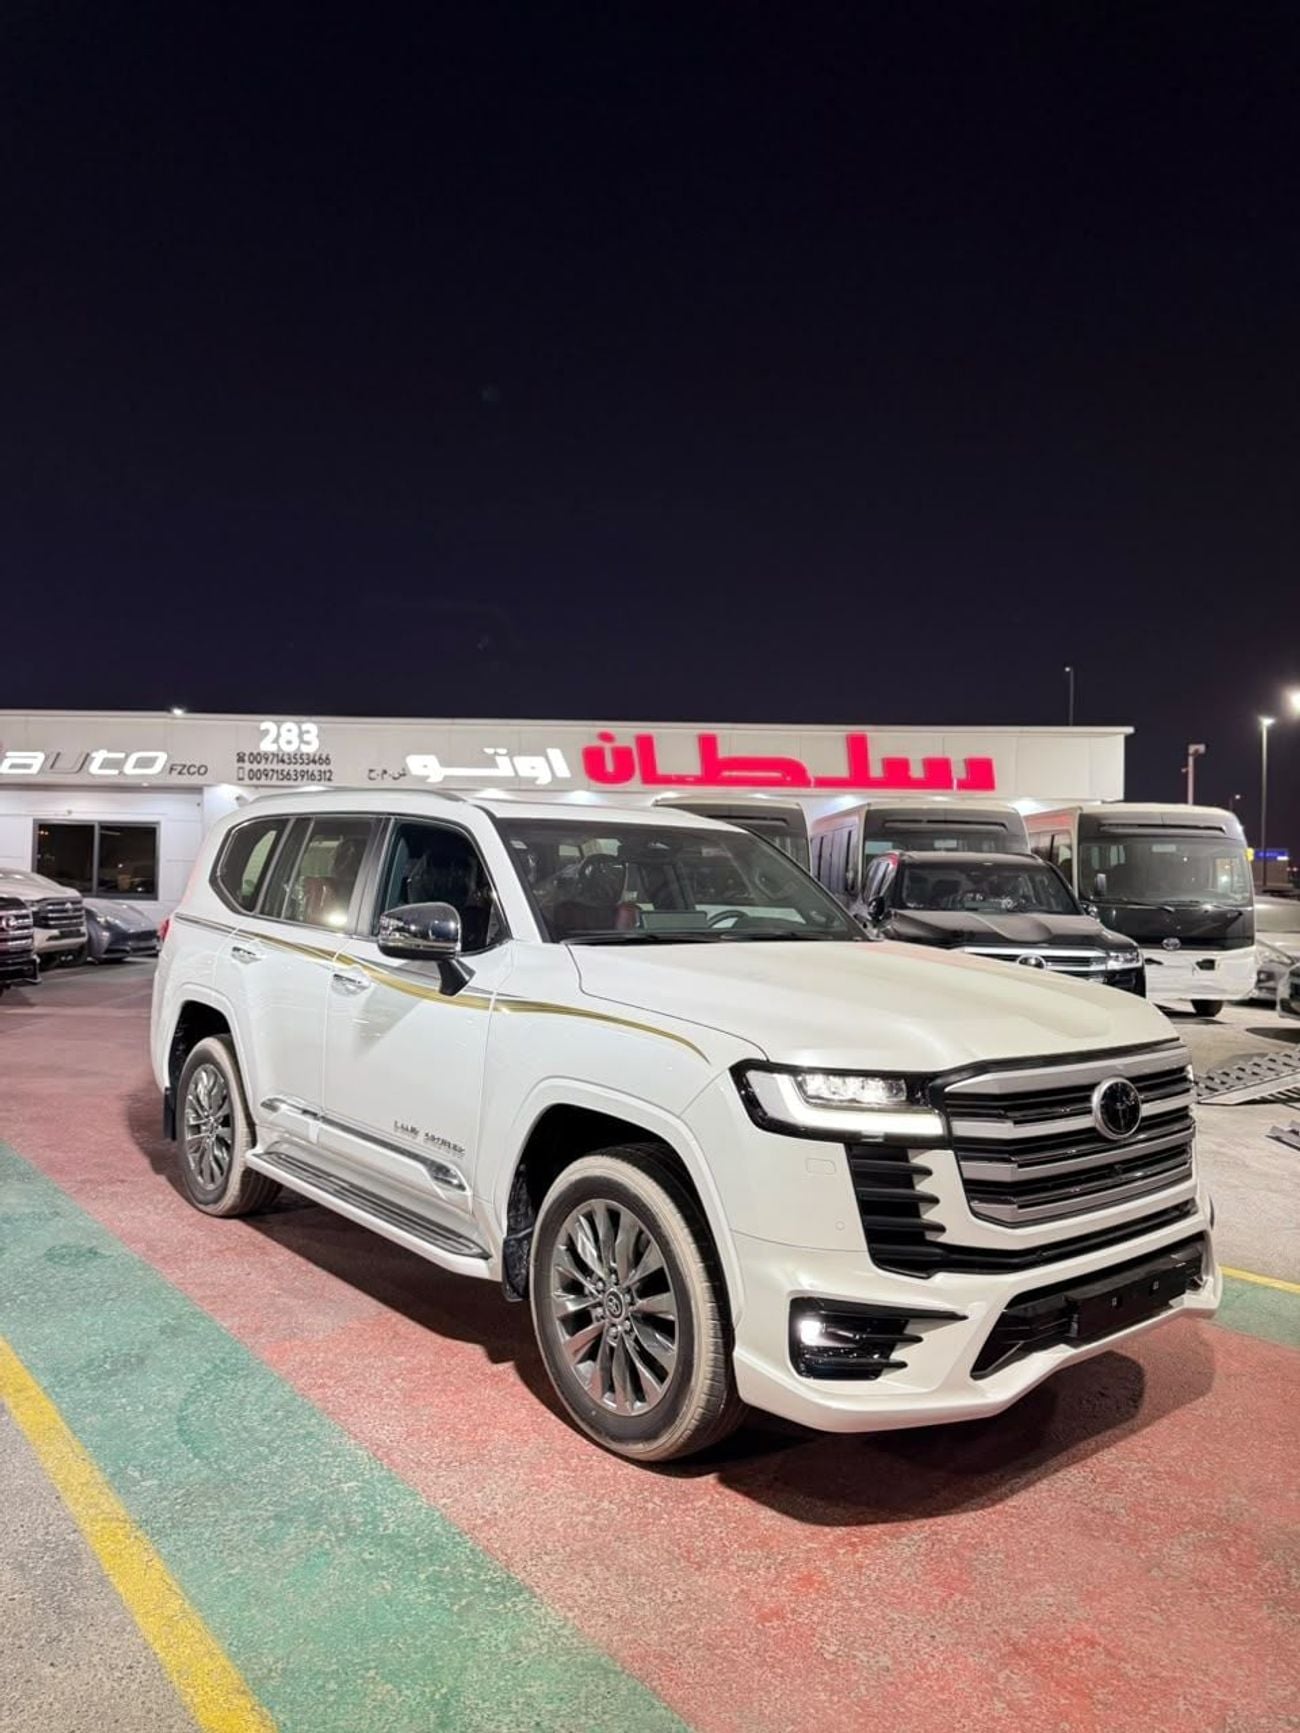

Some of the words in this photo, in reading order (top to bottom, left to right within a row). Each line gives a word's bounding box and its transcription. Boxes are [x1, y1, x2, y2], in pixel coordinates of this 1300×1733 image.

[259, 721, 319, 753] 283
[247, 752, 332, 765] 0097143553466
[582, 731, 997, 791] سلطان
[168, 763, 209, 776] FZCO
[247, 768, 334, 782] 00971563916312
